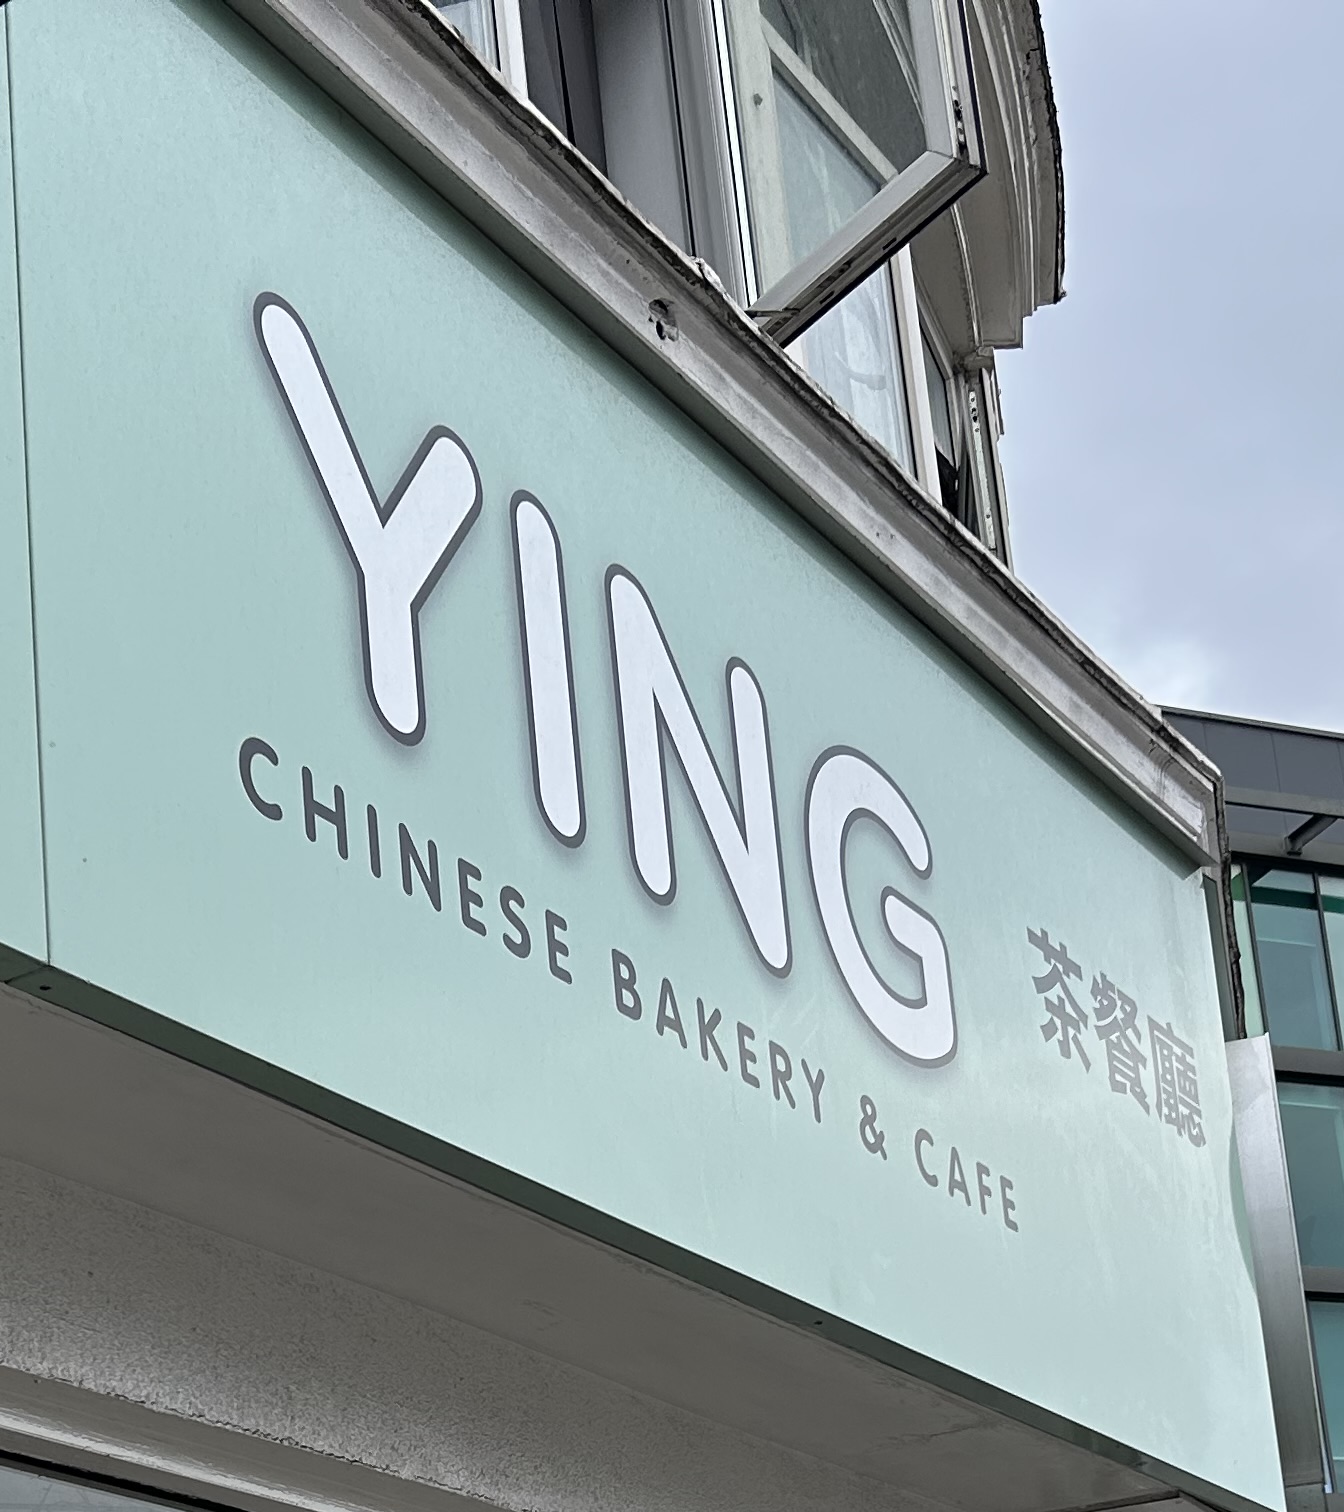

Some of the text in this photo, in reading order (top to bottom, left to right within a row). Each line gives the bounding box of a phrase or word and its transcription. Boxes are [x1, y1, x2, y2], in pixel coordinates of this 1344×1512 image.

[253, 292, 958, 1068] YING
[239, 737, 1019, 1233] CHINESE BAKERY & CAFE
[1027, 925, 1207, 1148] 茶餐廳
